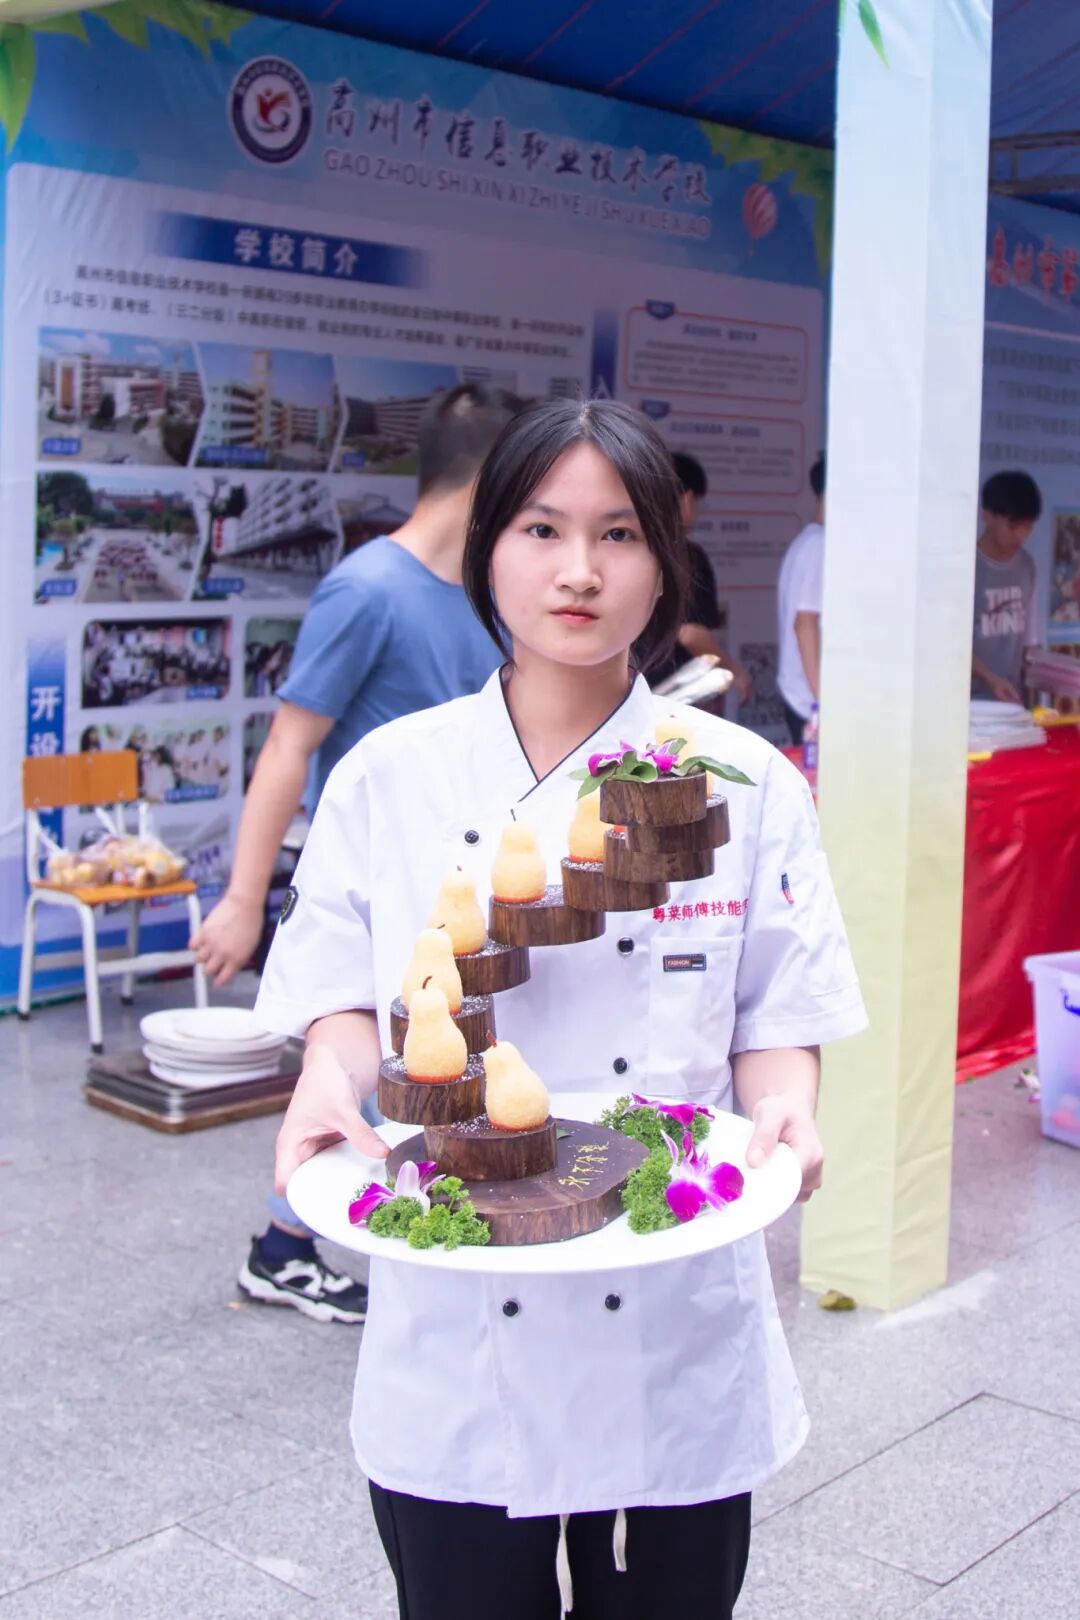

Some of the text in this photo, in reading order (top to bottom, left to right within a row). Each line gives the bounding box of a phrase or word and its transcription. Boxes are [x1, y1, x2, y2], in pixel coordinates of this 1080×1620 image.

[325, 79, 711, 203] 高州市信息职业技术学校
[323, 148, 370, 176] GAO
[373, 157, 432, 188] ZHOU
[233, 226, 359, 277] 学校简介
